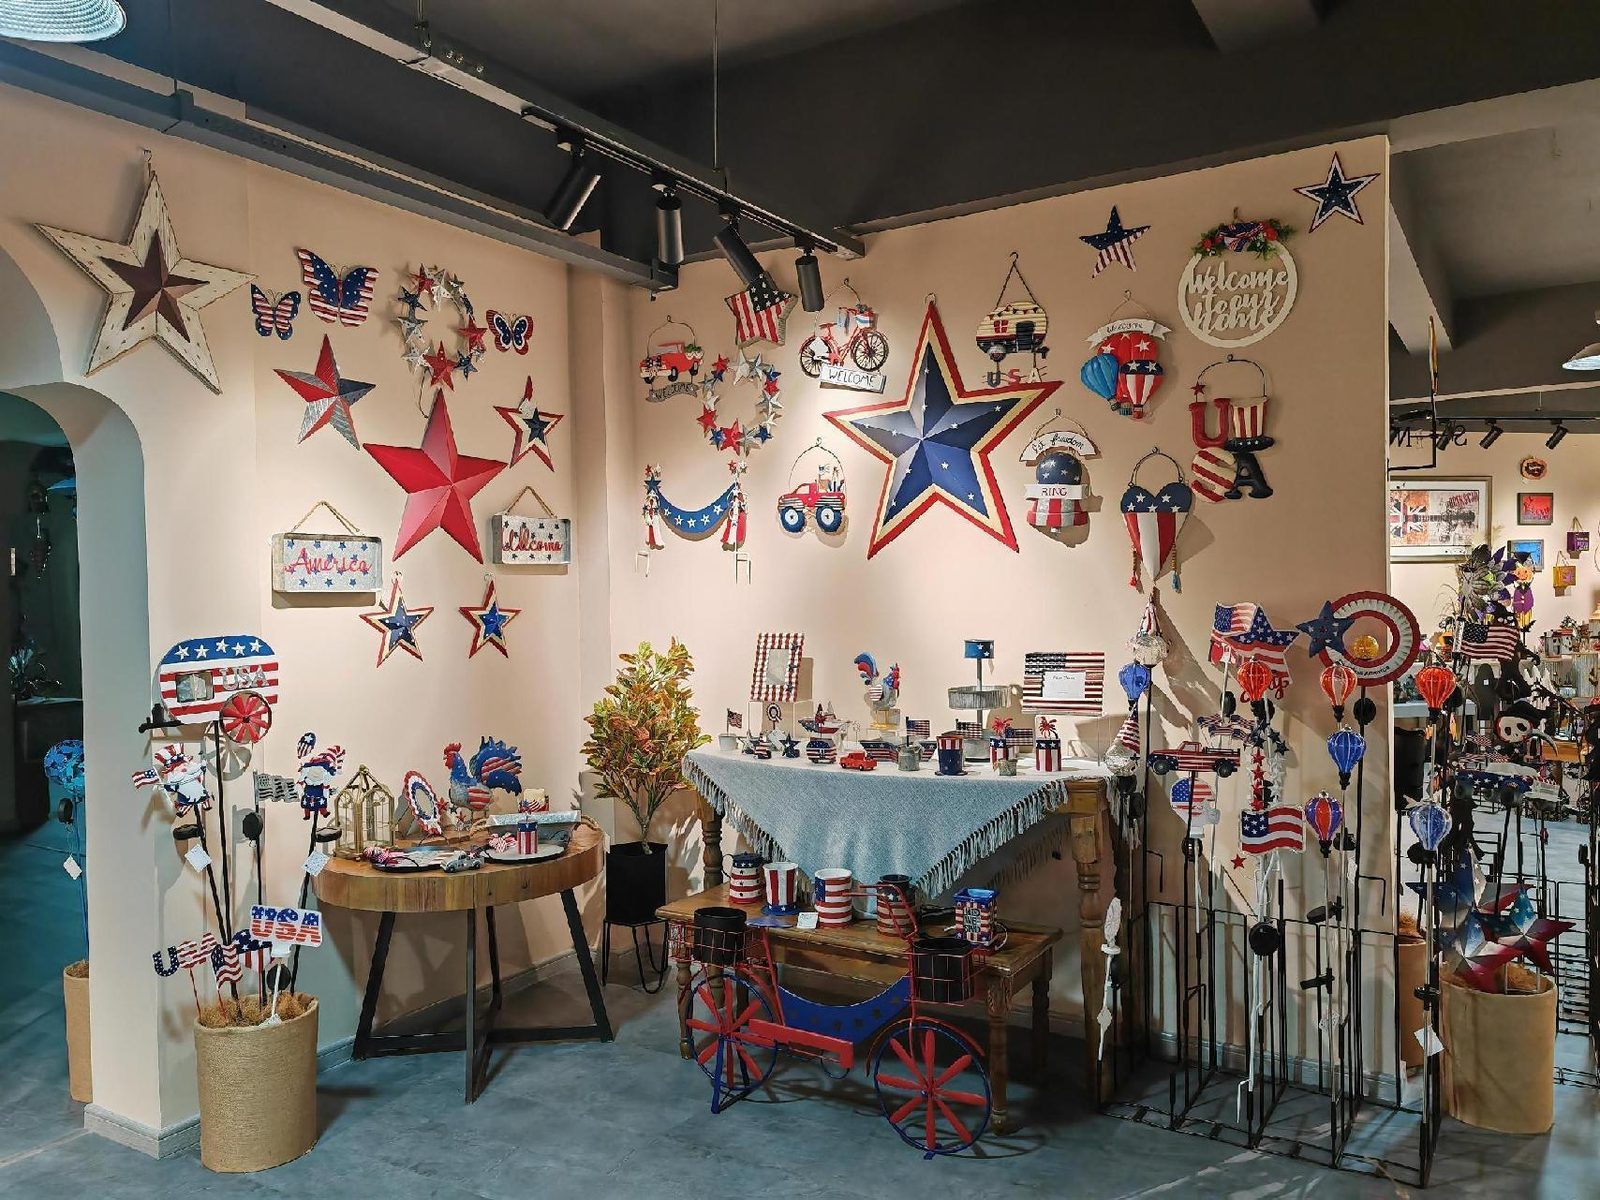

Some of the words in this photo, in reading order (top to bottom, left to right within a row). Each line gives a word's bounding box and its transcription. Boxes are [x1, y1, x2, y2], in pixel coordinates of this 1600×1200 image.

[829, 368, 877, 388] WELCOME
[1041, 487, 1067, 497] RING
[283, 547, 372, 575] America
[219, 664, 270, 691] USA
[252, 906, 321, 943] USA
